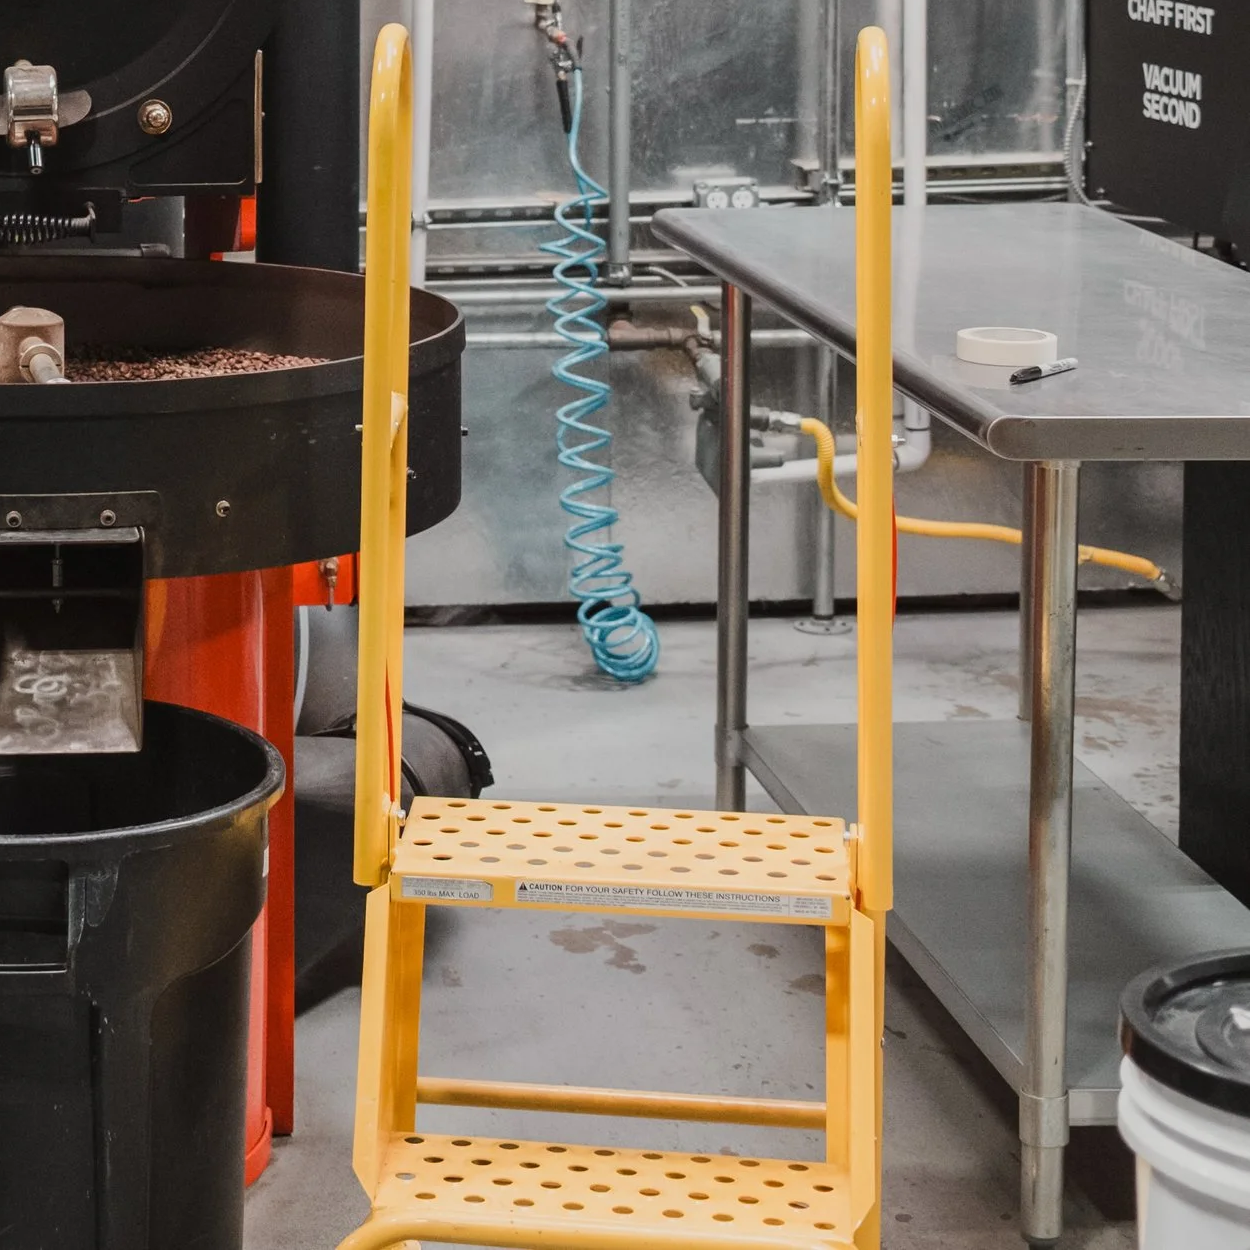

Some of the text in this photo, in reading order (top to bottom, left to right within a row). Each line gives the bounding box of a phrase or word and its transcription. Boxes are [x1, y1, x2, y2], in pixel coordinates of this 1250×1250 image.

[1174, 2, 1216, 36] FIRST
[1141, 62, 1203, 101] VACUUM
[1141, 91, 1201, 130] SECOND
[427, 889, 437, 897] lbs
[438, 890, 455, 898] MAX
[458, 891, 480, 899] LOAD
[529, 882, 781, 903] CAUTION FOR YOUR SAFETY FOLLOW THESE INSTRUCTIONS
